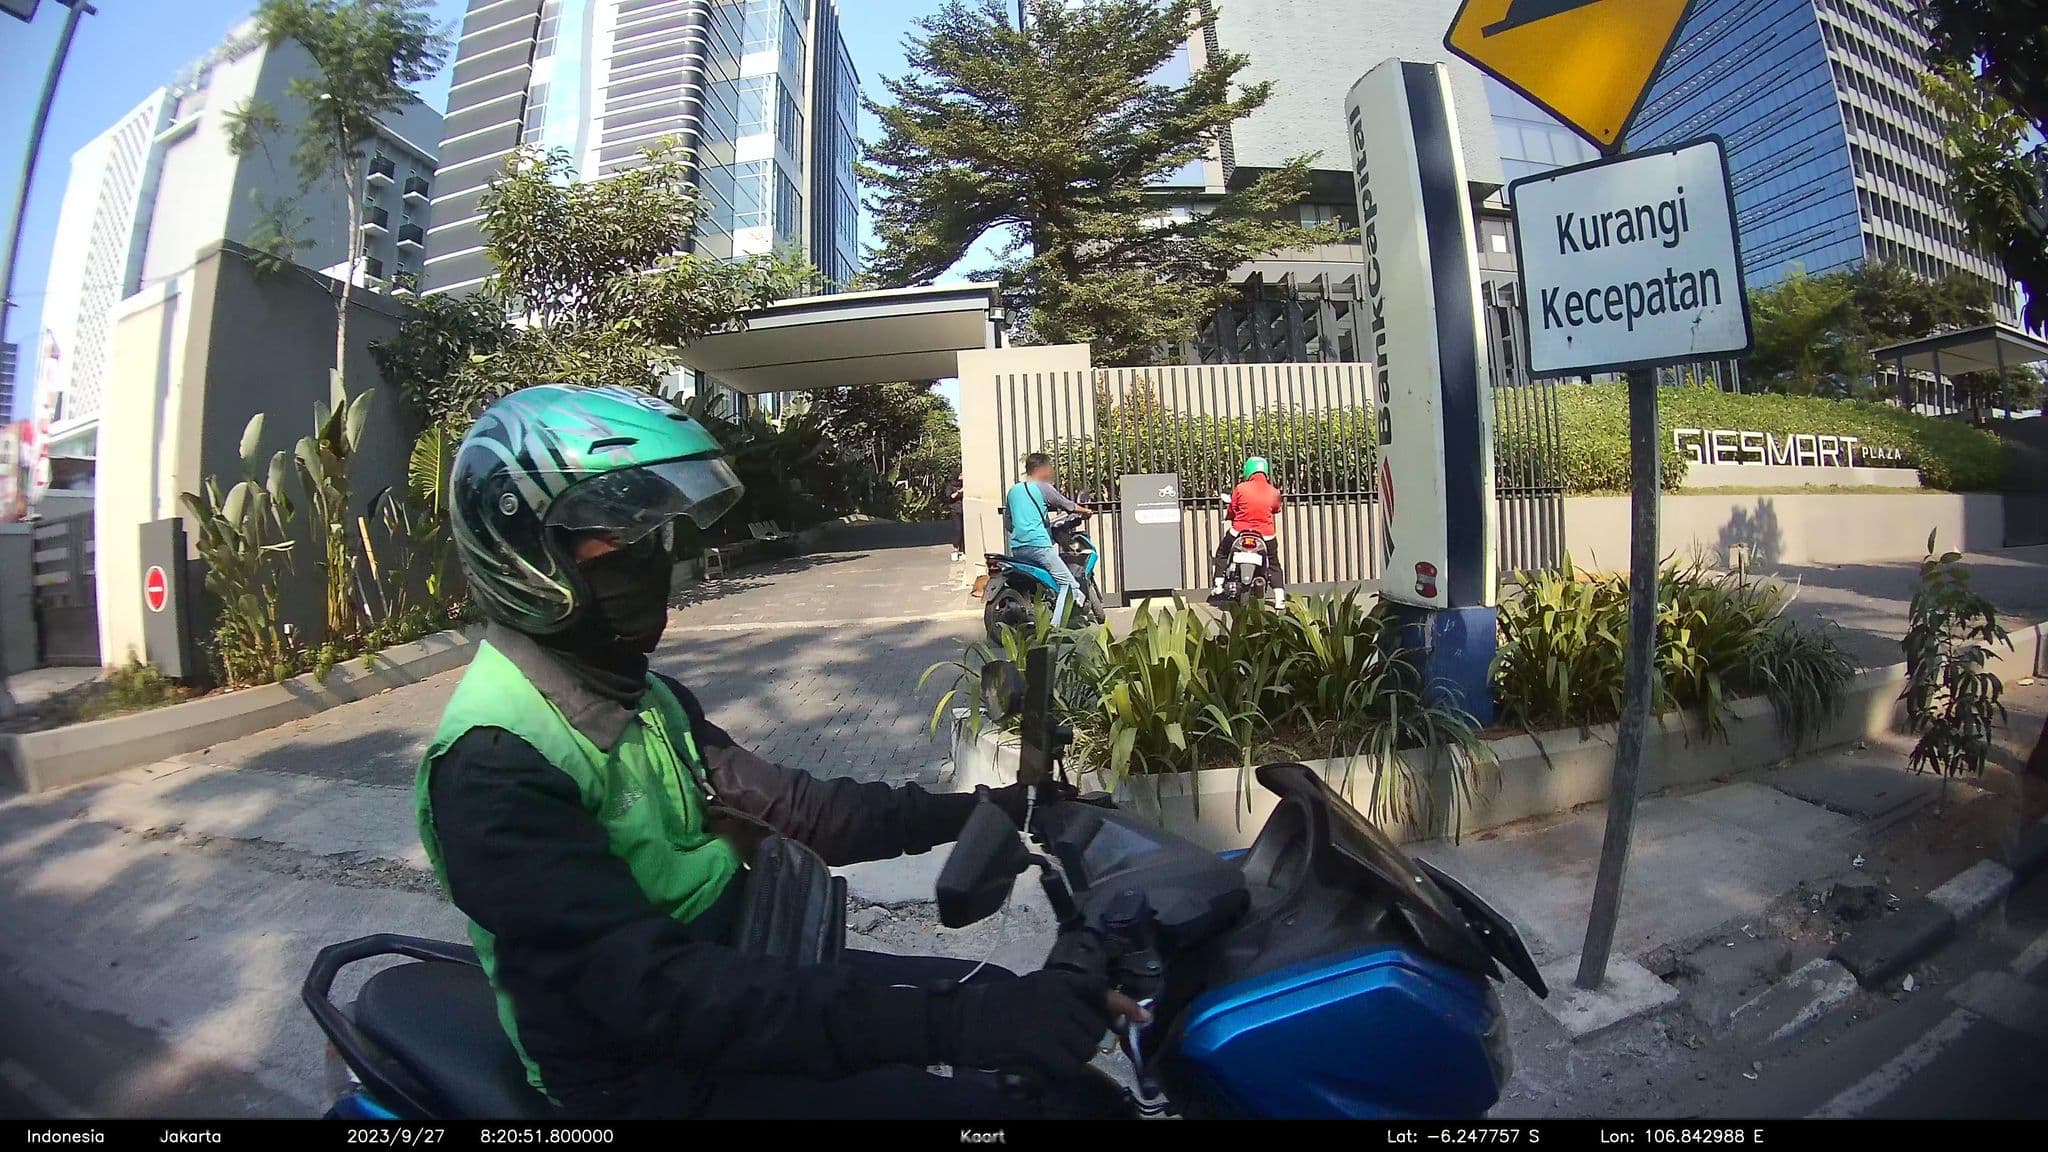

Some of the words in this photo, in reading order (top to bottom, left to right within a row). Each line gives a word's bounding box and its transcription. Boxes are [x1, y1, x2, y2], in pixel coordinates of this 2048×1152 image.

[1555, 185, 1690, 256] Kurangi
[1349, 104, 1392, 446] BankCapital
[1541, 266, 1723, 332] Kecepatan
[1673, 428, 1858, 469] GIESMART
[1862, 446, 1902, 461] PLAZA
